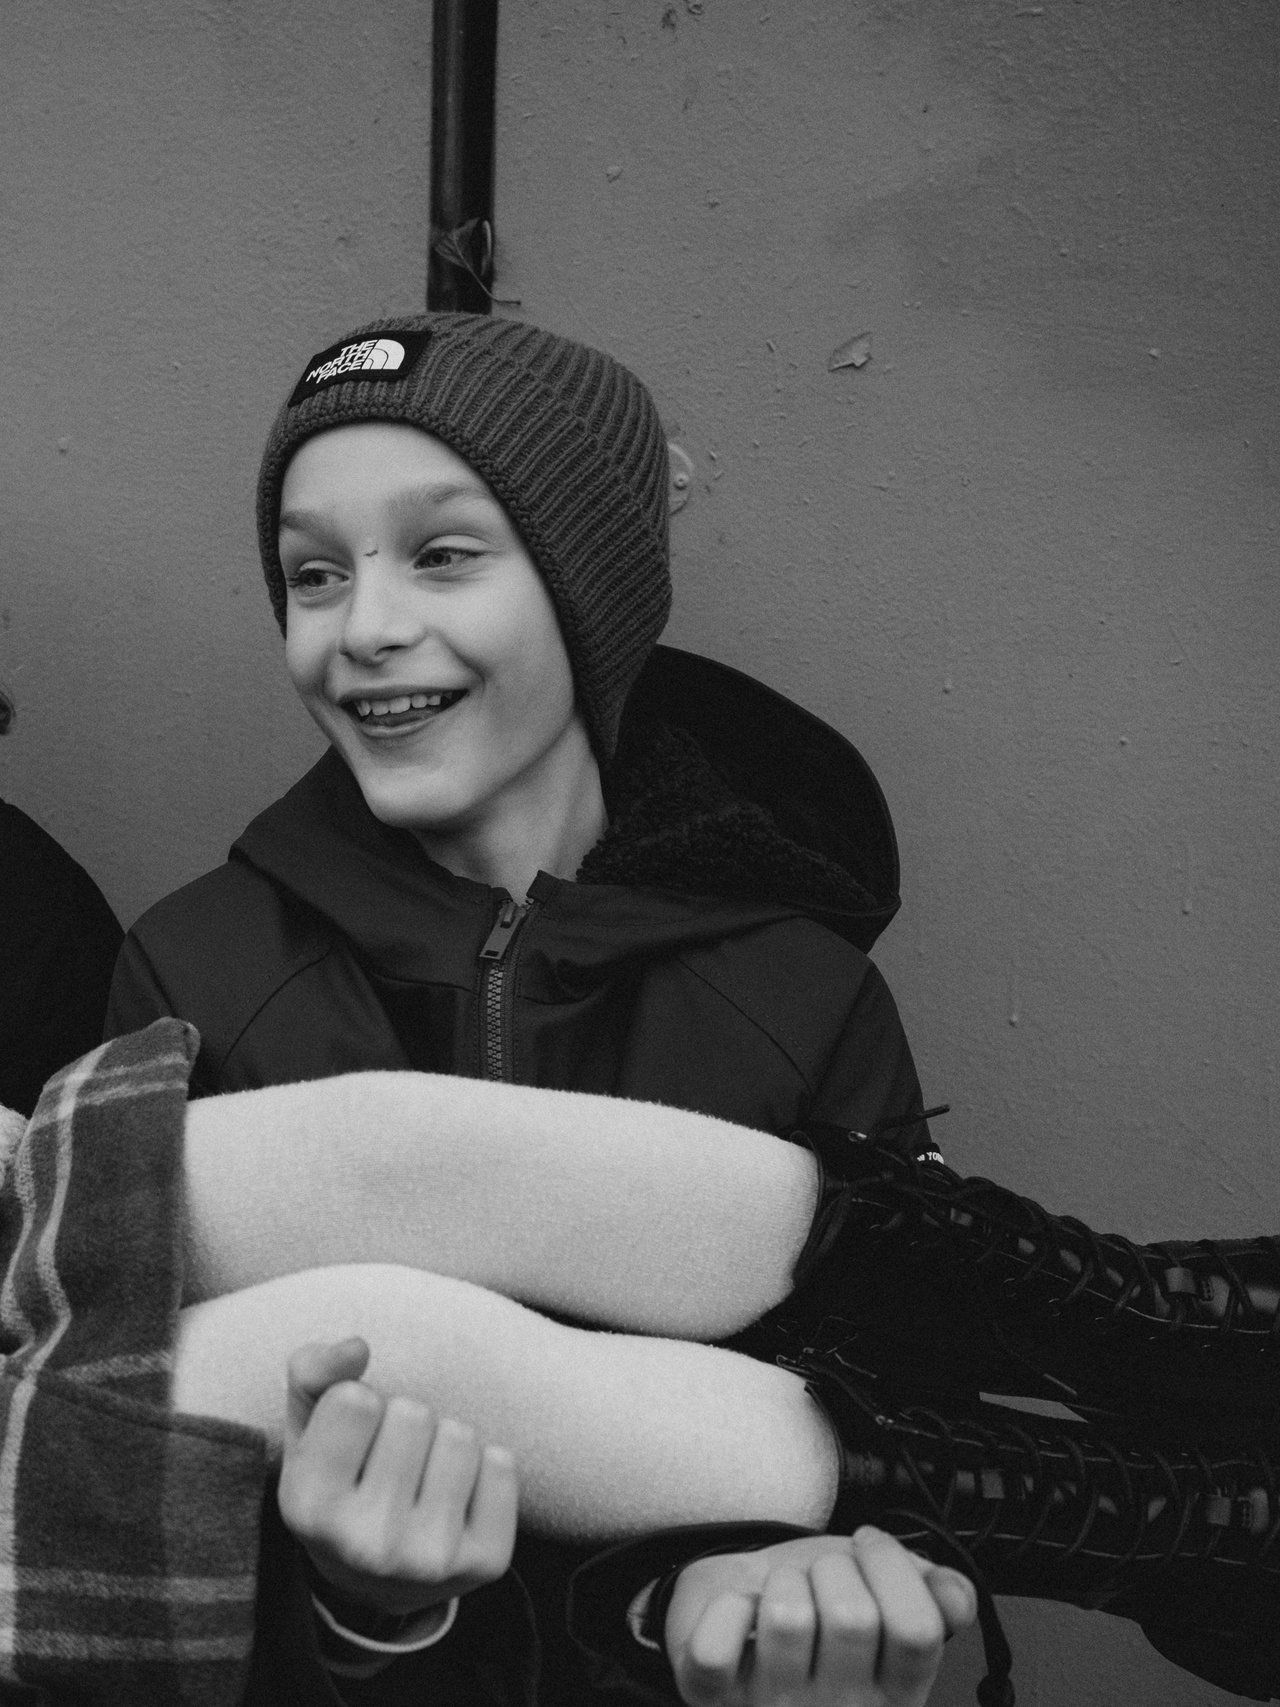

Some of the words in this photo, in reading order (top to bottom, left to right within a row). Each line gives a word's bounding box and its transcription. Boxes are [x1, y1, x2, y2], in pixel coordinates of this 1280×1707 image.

[340, 341, 378, 358] THE
[306, 350, 370, 382] NORTH
[316, 360, 364, 384] FACE
